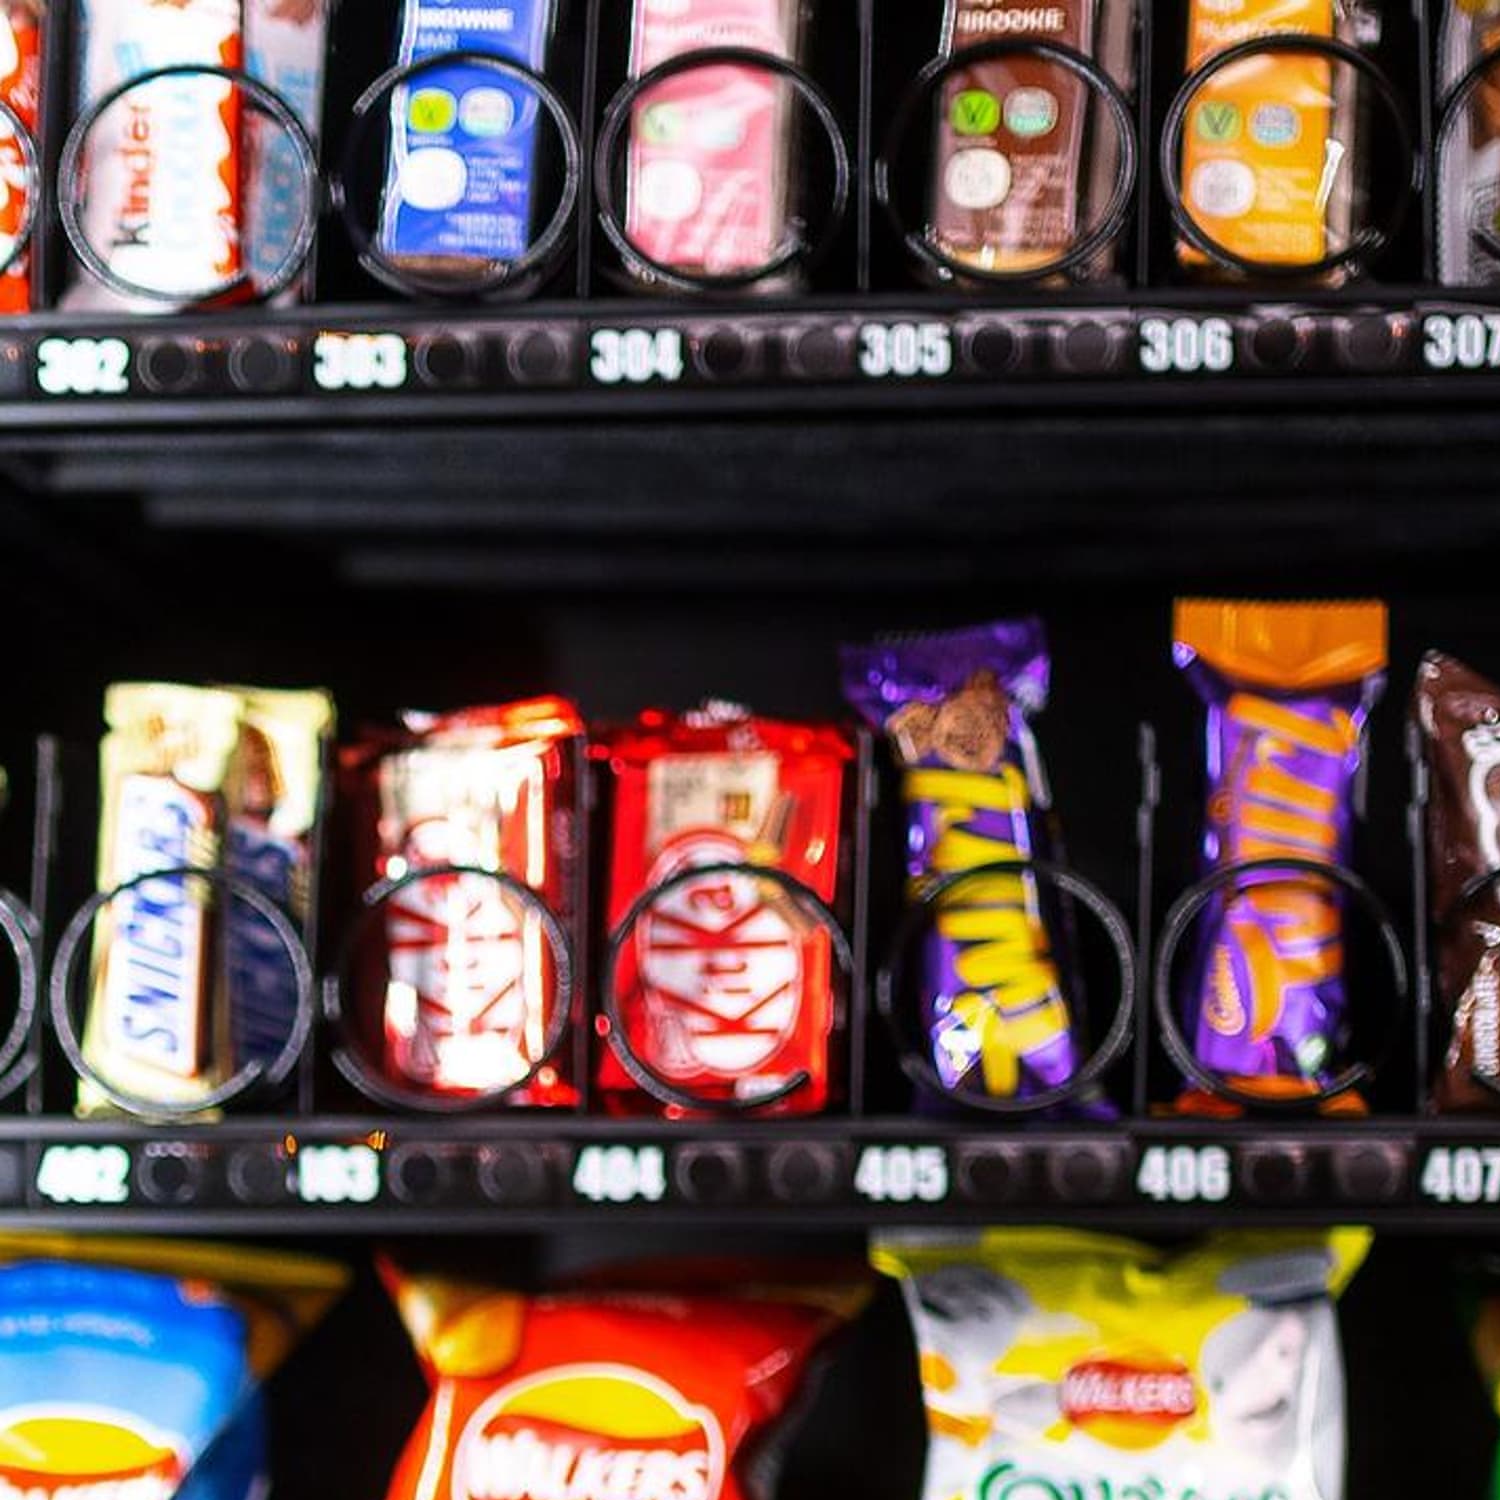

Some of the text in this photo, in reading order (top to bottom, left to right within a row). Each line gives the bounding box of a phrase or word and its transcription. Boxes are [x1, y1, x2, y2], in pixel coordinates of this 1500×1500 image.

[590, 329, 683, 382] 304
[859, 322, 952, 377] 305
[1139, 317, 1234, 372] 306
[648, 868, 792, 1039] KitKa
[574, 1146, 667, 1202] 404
[855, 1146, 948, 1201] 405
[1138, 1146, 1231, 1201] 406
